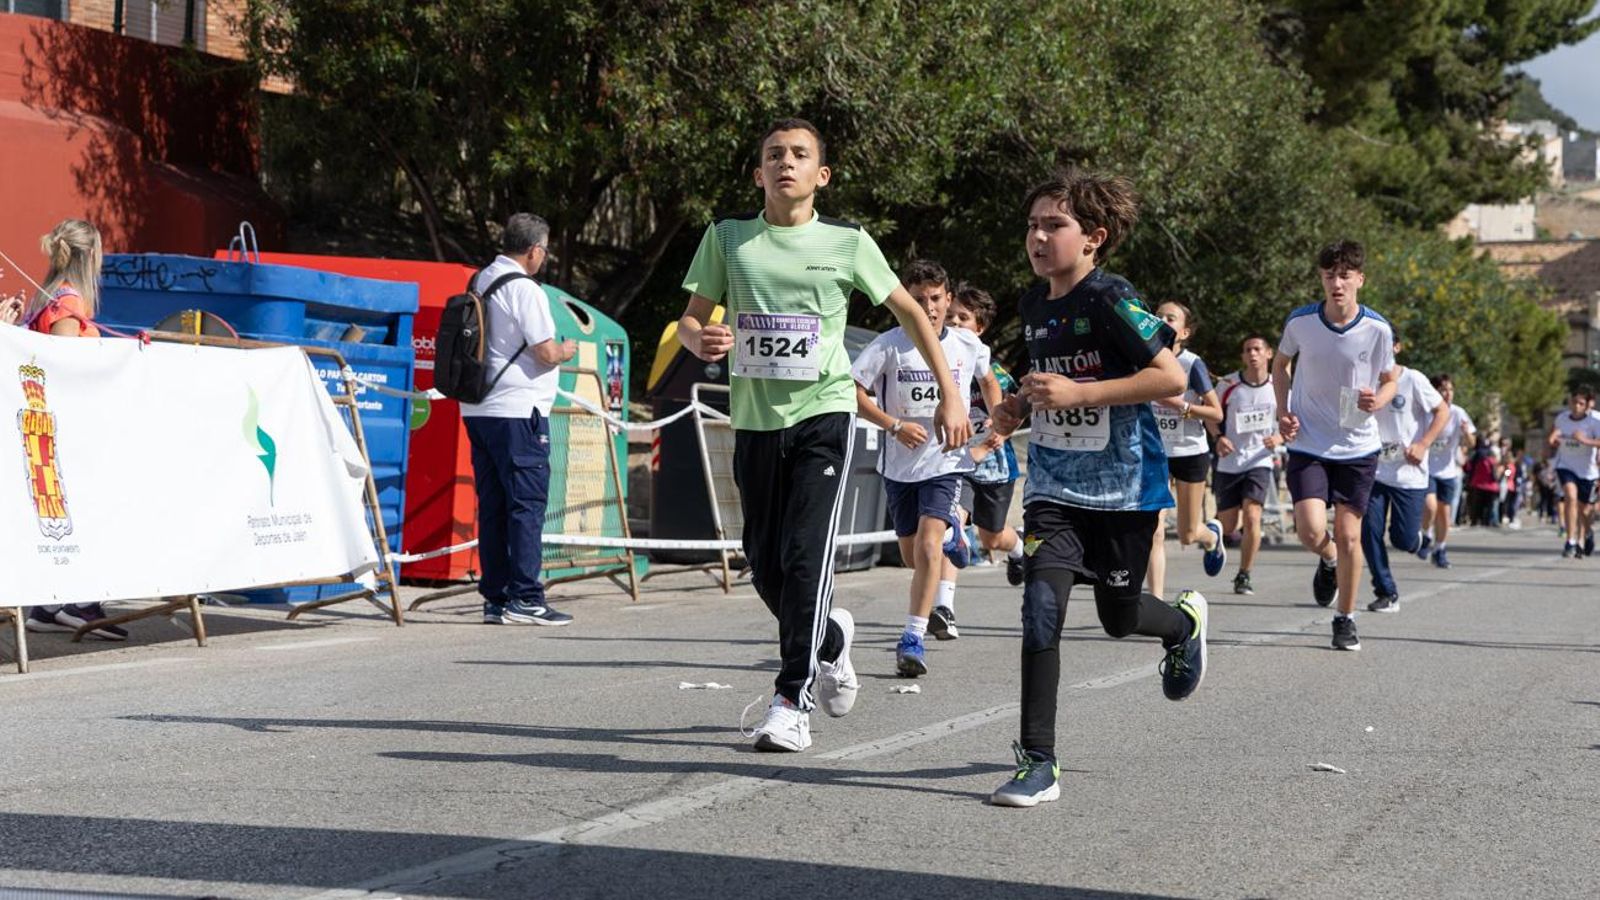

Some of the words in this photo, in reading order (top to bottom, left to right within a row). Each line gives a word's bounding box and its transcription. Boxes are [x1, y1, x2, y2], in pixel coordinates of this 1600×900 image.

[745, 336, 809, 358] 1524
[1031, 350, 1101, 373] LANTÓN
[1045, 405, 1099, 426] 1385
[1158, 418, 1177, 430] 69
[1243, 412, 1264, 424] 312
